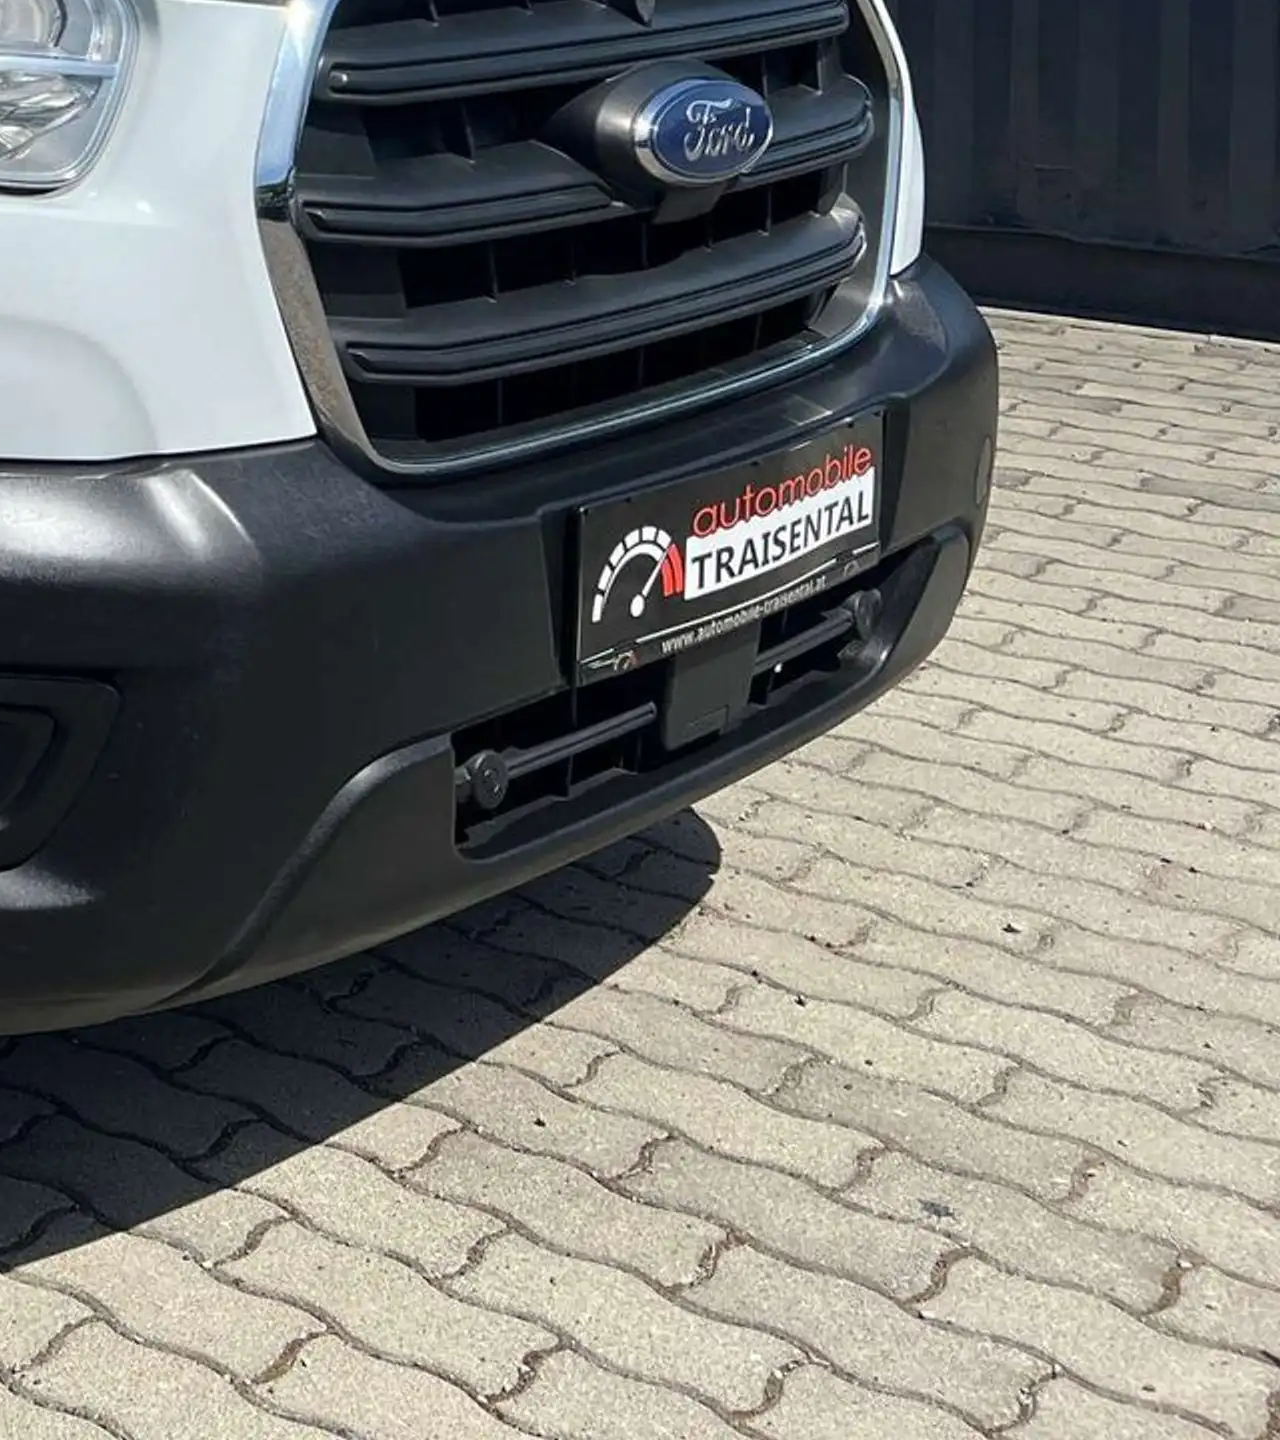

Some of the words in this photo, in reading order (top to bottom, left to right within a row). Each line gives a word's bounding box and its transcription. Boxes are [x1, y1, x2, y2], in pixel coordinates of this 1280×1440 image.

[683, 98, 756, 161] Ford
[692, 444, 872, 537] automobile
[690, 490, 870, 590] TRAISENTAL
